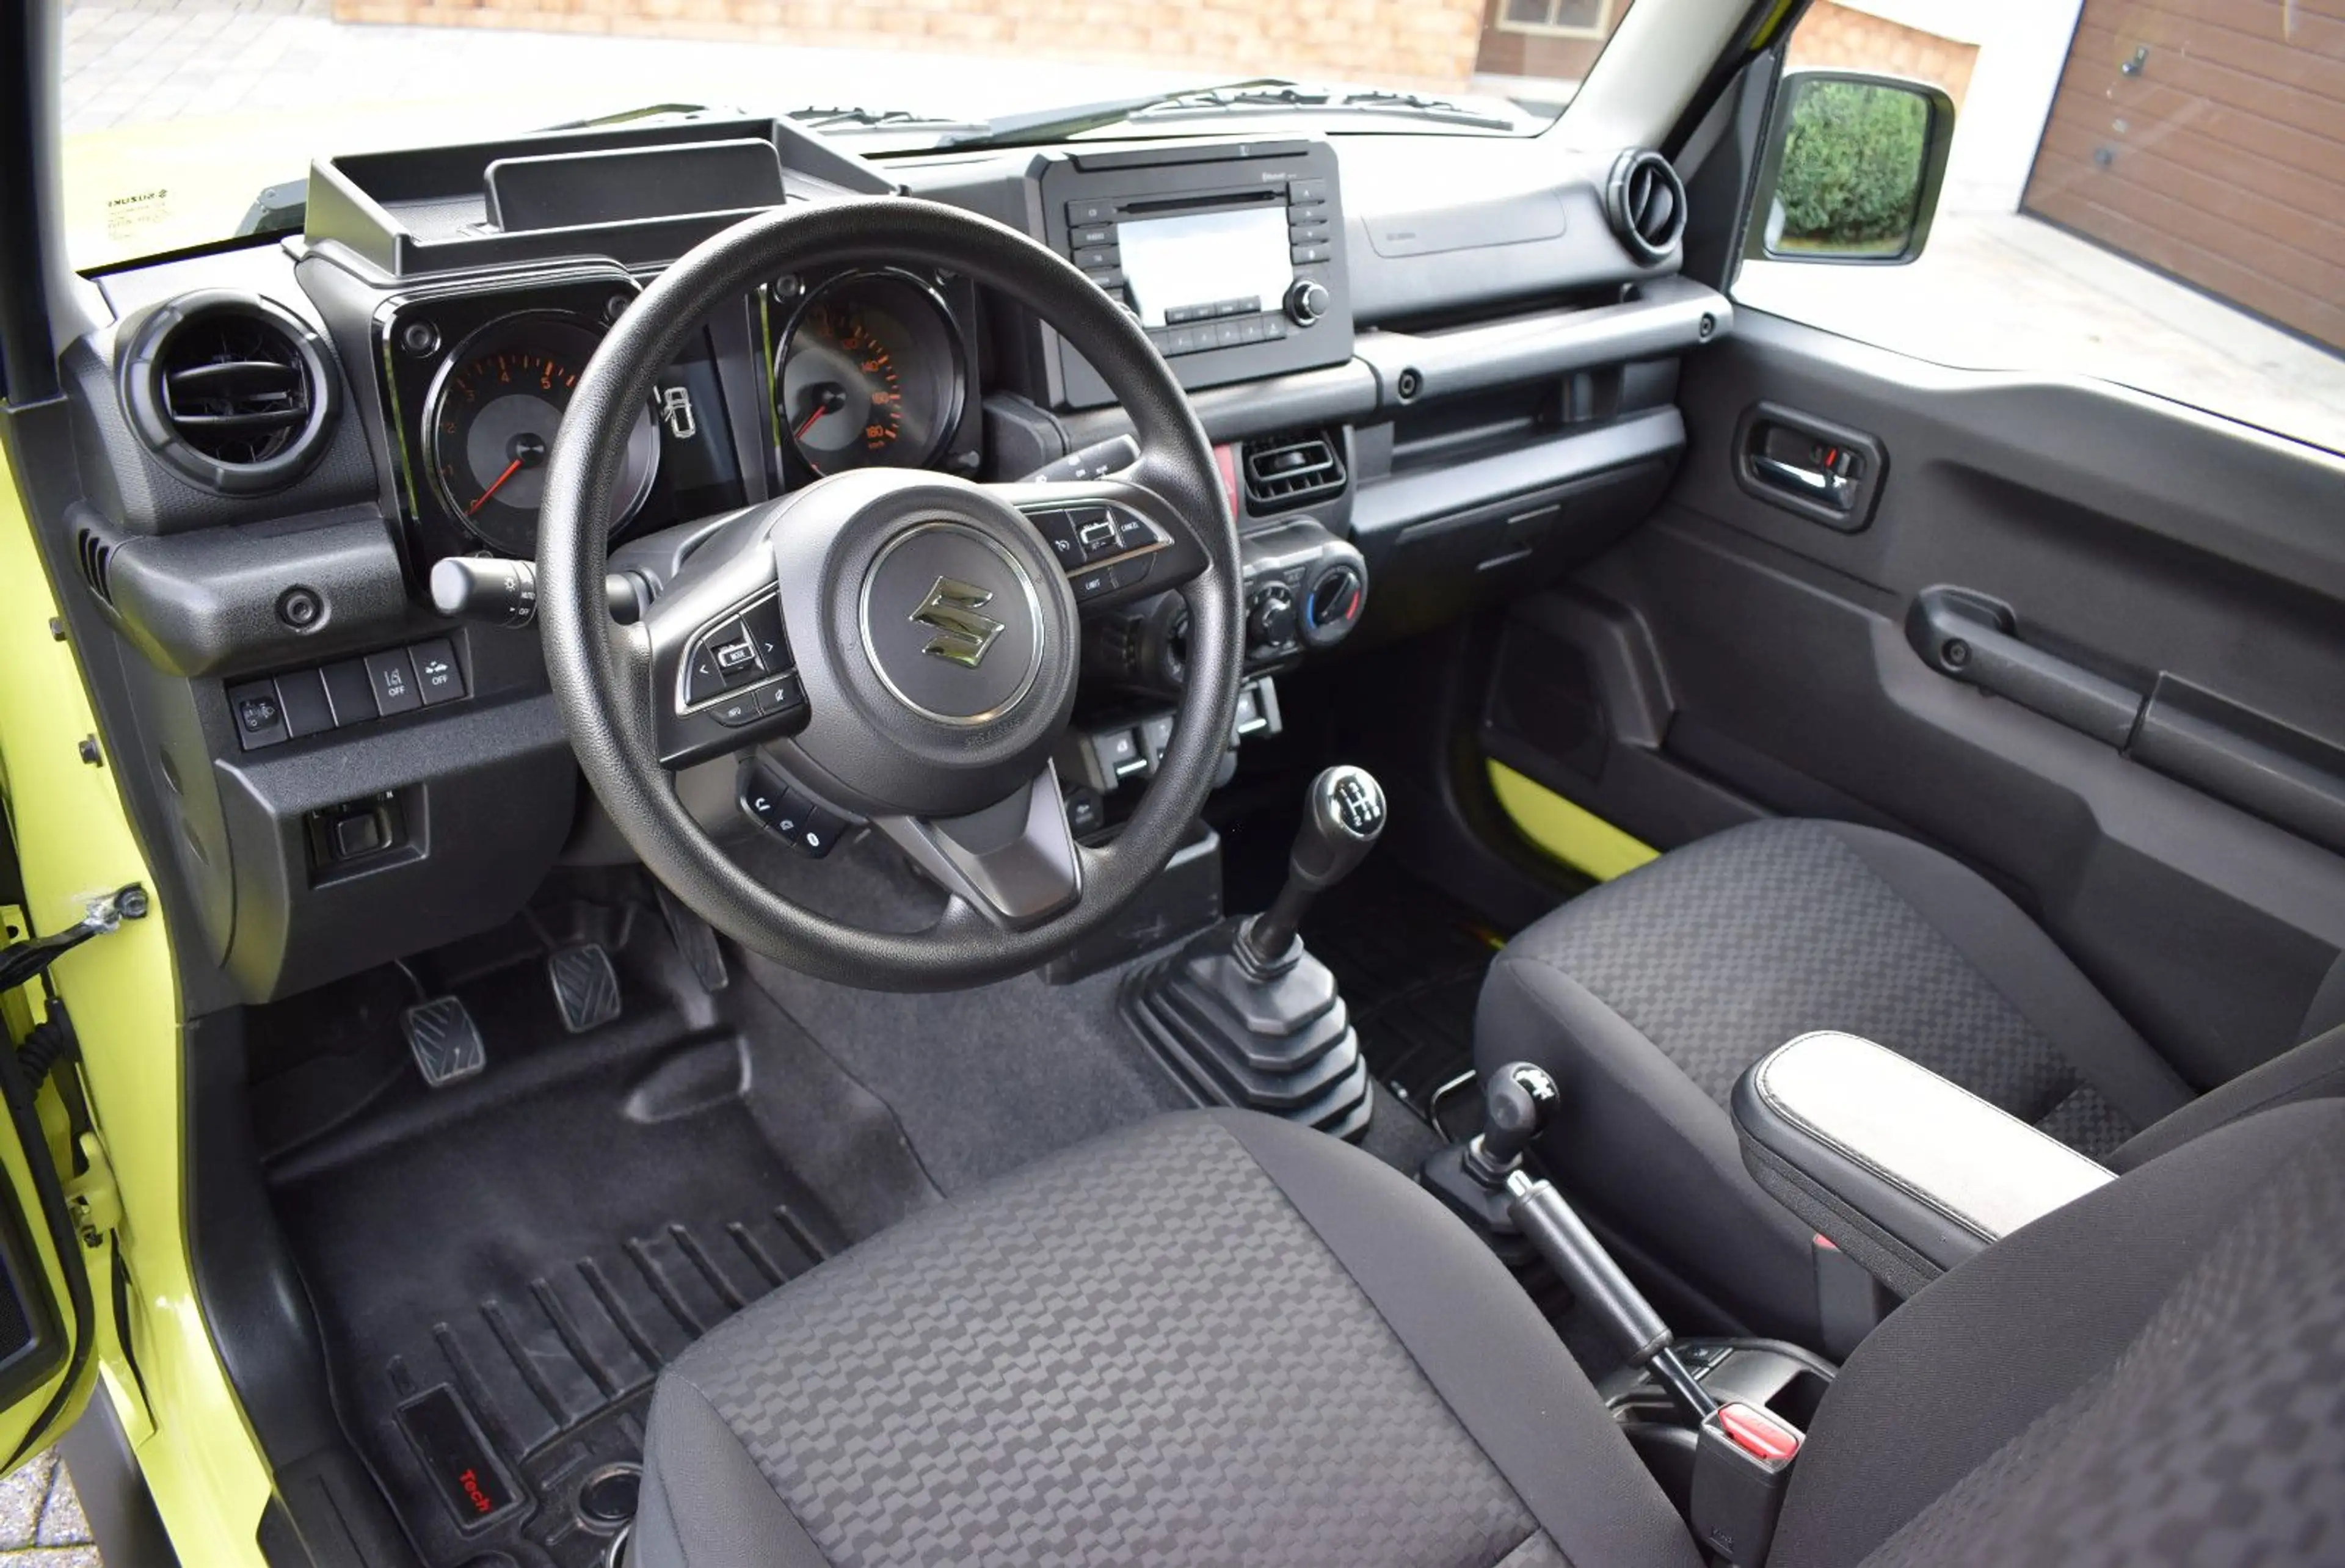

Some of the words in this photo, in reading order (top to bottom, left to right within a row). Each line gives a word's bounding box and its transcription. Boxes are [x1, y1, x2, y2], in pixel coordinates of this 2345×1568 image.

[432, 674, 448, 685] OFF
[388, 685, 405, 697] OFF
[459, 1468, 490, 1512] Tech
